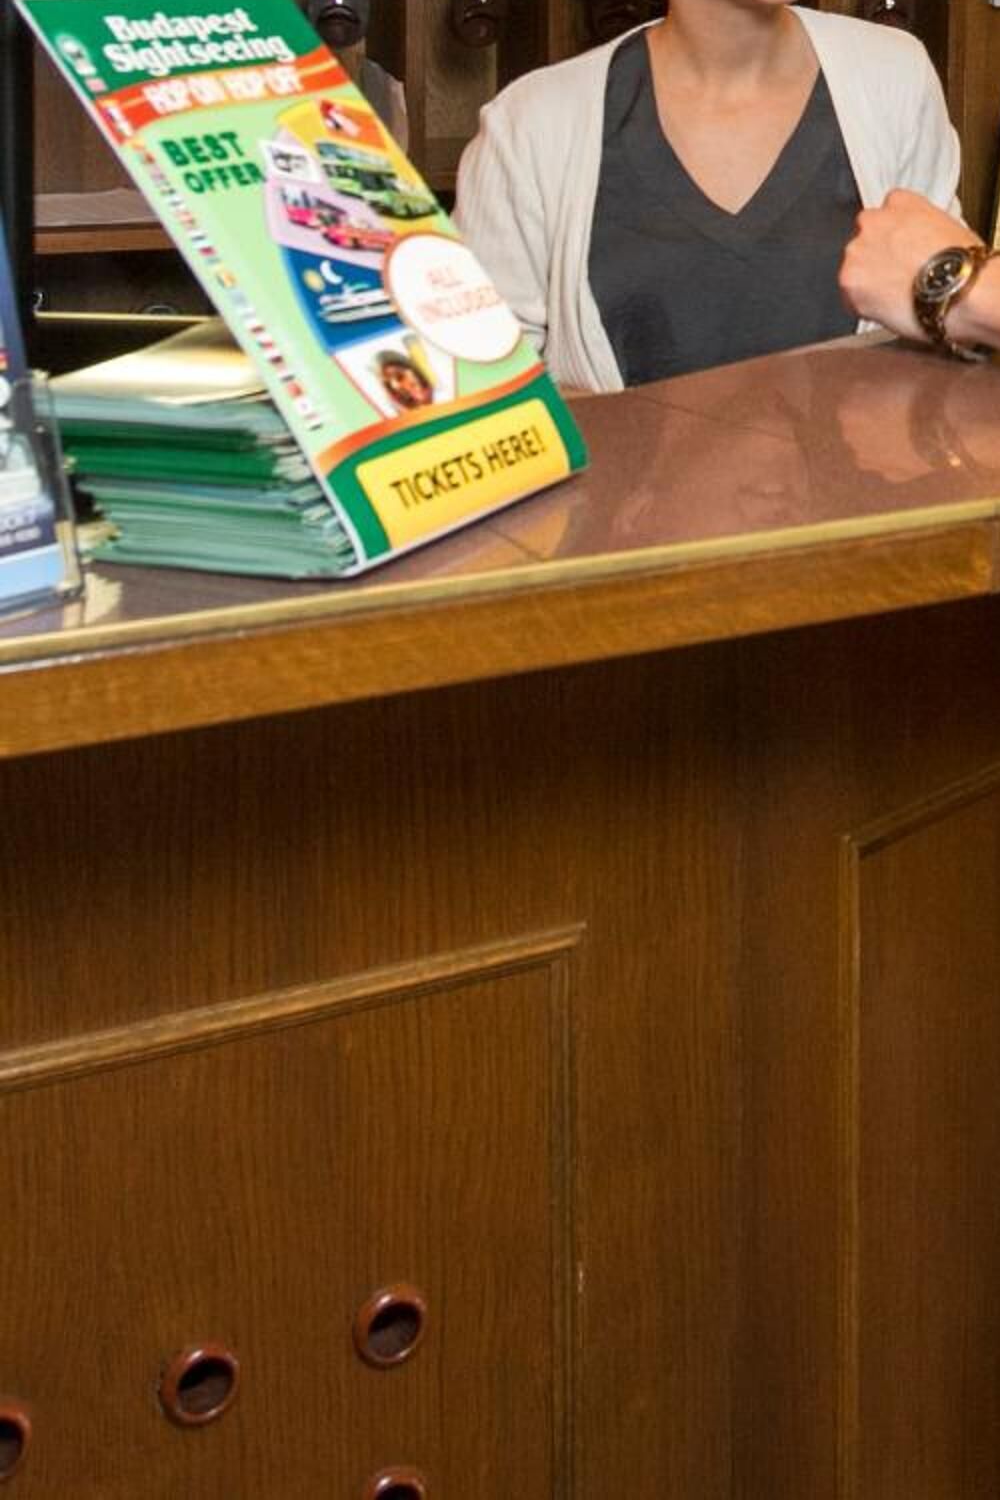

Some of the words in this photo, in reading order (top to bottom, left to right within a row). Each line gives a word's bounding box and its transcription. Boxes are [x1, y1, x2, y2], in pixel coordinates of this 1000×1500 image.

[103, 8, 258, 43] Budapest
[102, 34, 297, 77] Sightseeing
[160, 132, 244, 167] BEST
[183, 162, 266, 194] OFFER
[389, 451, 484, 510] TICKETS
[482, 425, 548, 474] HERE!
